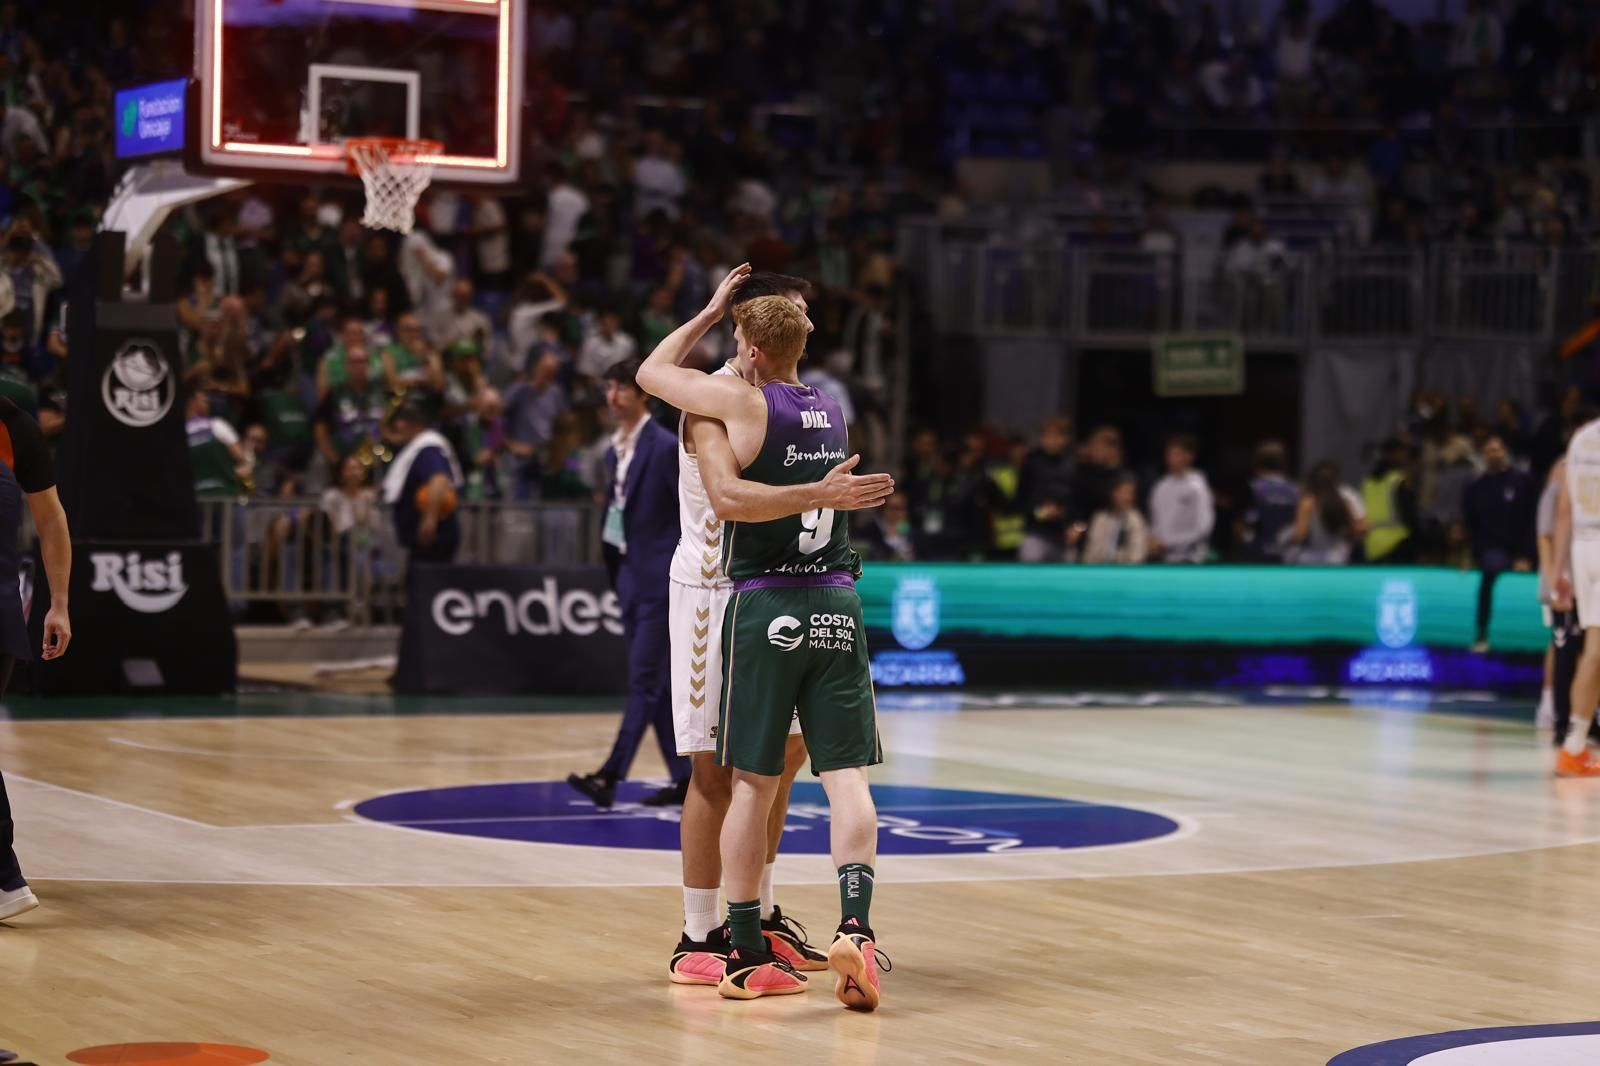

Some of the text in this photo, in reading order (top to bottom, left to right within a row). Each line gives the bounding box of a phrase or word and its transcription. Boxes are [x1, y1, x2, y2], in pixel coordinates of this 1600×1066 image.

[800, 406, 832, 429] DÍAZ
[90, 551, 189, 613] Risi
[809, 613, 856, 629] COSTA
[809, 627, 855, 642] DEL SOL
[808, 637, 852, 653] MÁLAGA
[847, 870, 860, 899] UNICAJA
